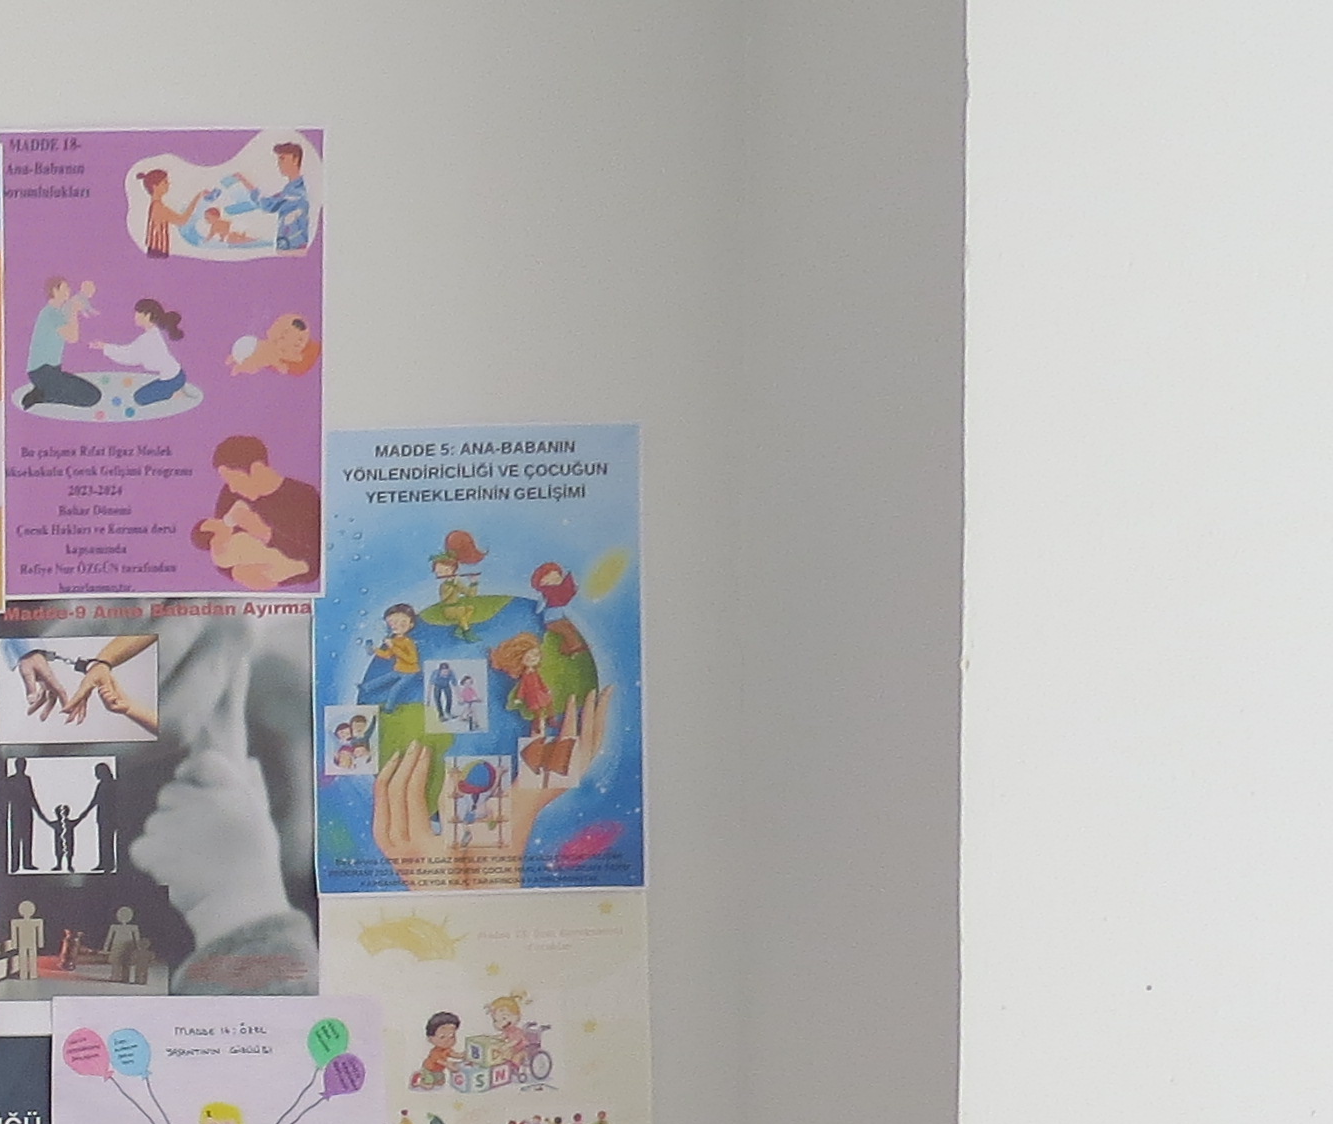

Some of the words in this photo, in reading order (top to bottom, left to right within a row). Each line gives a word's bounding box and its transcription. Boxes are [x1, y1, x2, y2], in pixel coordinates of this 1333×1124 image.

[374, 443, 436, 458] MADDE
[440, 442, 456, 457] 5:
[459, 440, 576, 456] ANA-BABANIN
[342, 458, 494, 482] YÖNLENDİRİCİLİĞİ
[497, 463, 520, 478] VE
[523, 461, 608, 481] ÇOCUĞUN
[365, 484, 510, 504] YETENEKLERİNİN
[513, 483, 586, 503] GELİŞİMİ
